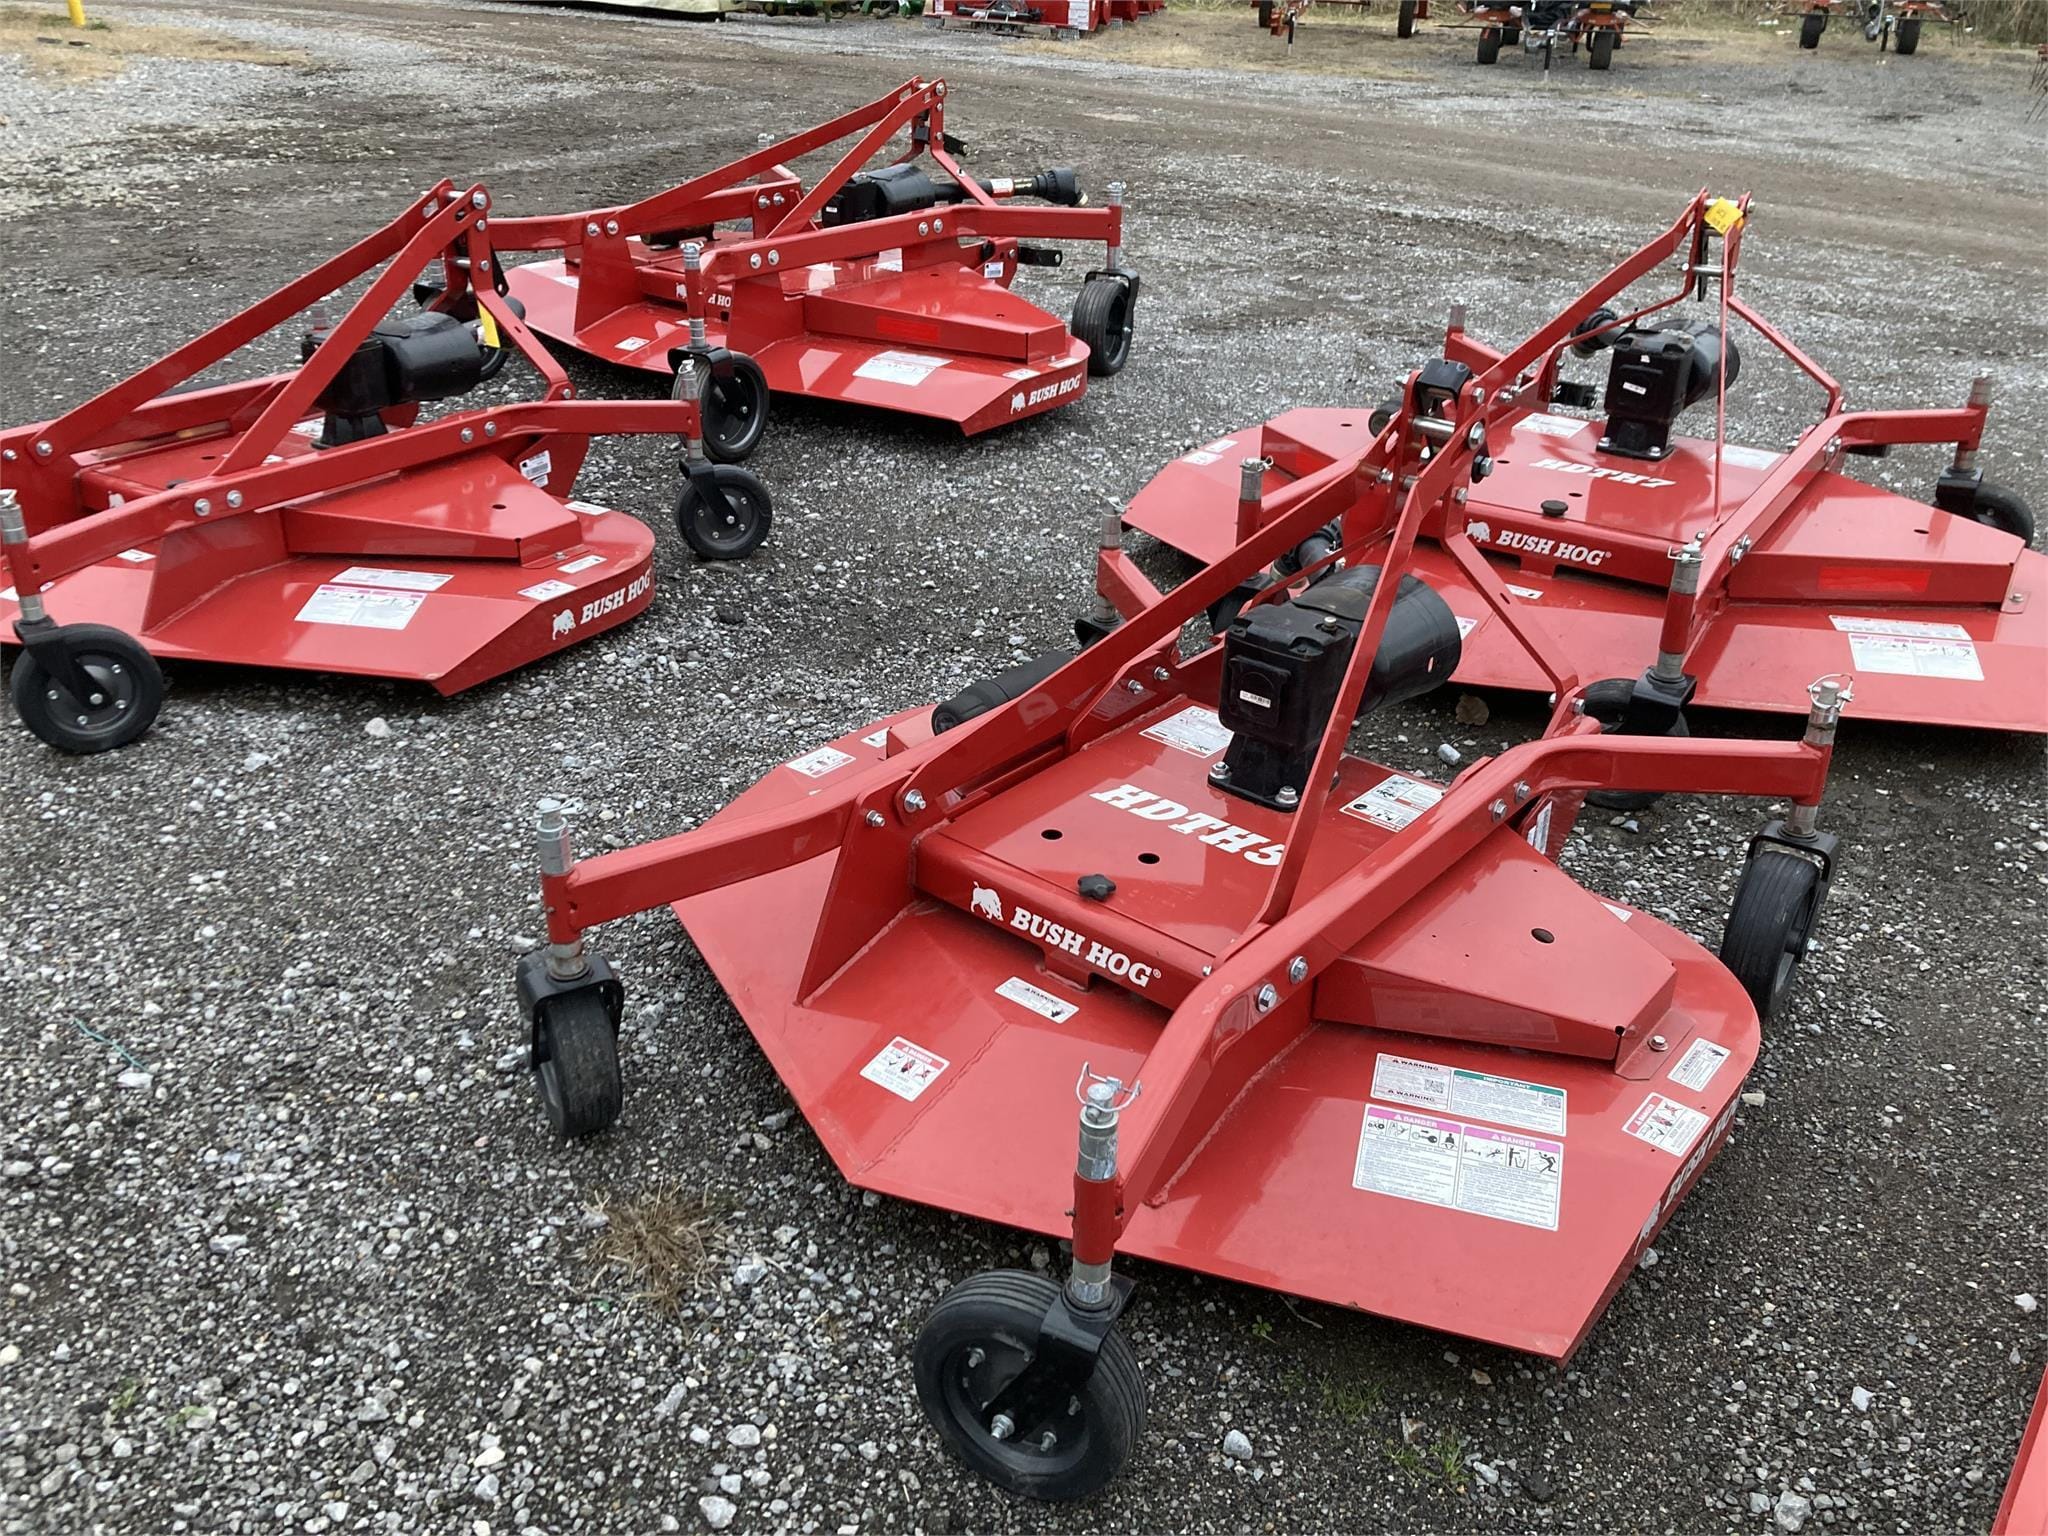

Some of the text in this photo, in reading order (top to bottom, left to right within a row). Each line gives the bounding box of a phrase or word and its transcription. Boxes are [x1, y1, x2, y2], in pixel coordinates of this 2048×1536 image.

[717, 292, 732, 308] HO
[1028, 382, 1059, 406] BUSH
[1529, 458, 1676, 489] HDTH7
[1496, 530, 1556, 556] BUSH
[580, 588, 626, 624] BUSH
[627, 567, 651, 602] HOG
[1089, 784, 1286, 866] HDTH5
[1010, 906, 1086, 956] BUSH
[1401, 1060, 1439, 1071] WARNING
[1397, 1090, 1435, 1102] WARNING
[1404, 1115, 1438, 1128] DANGER
[1501, 1136, 1536, 1148] DANGER
